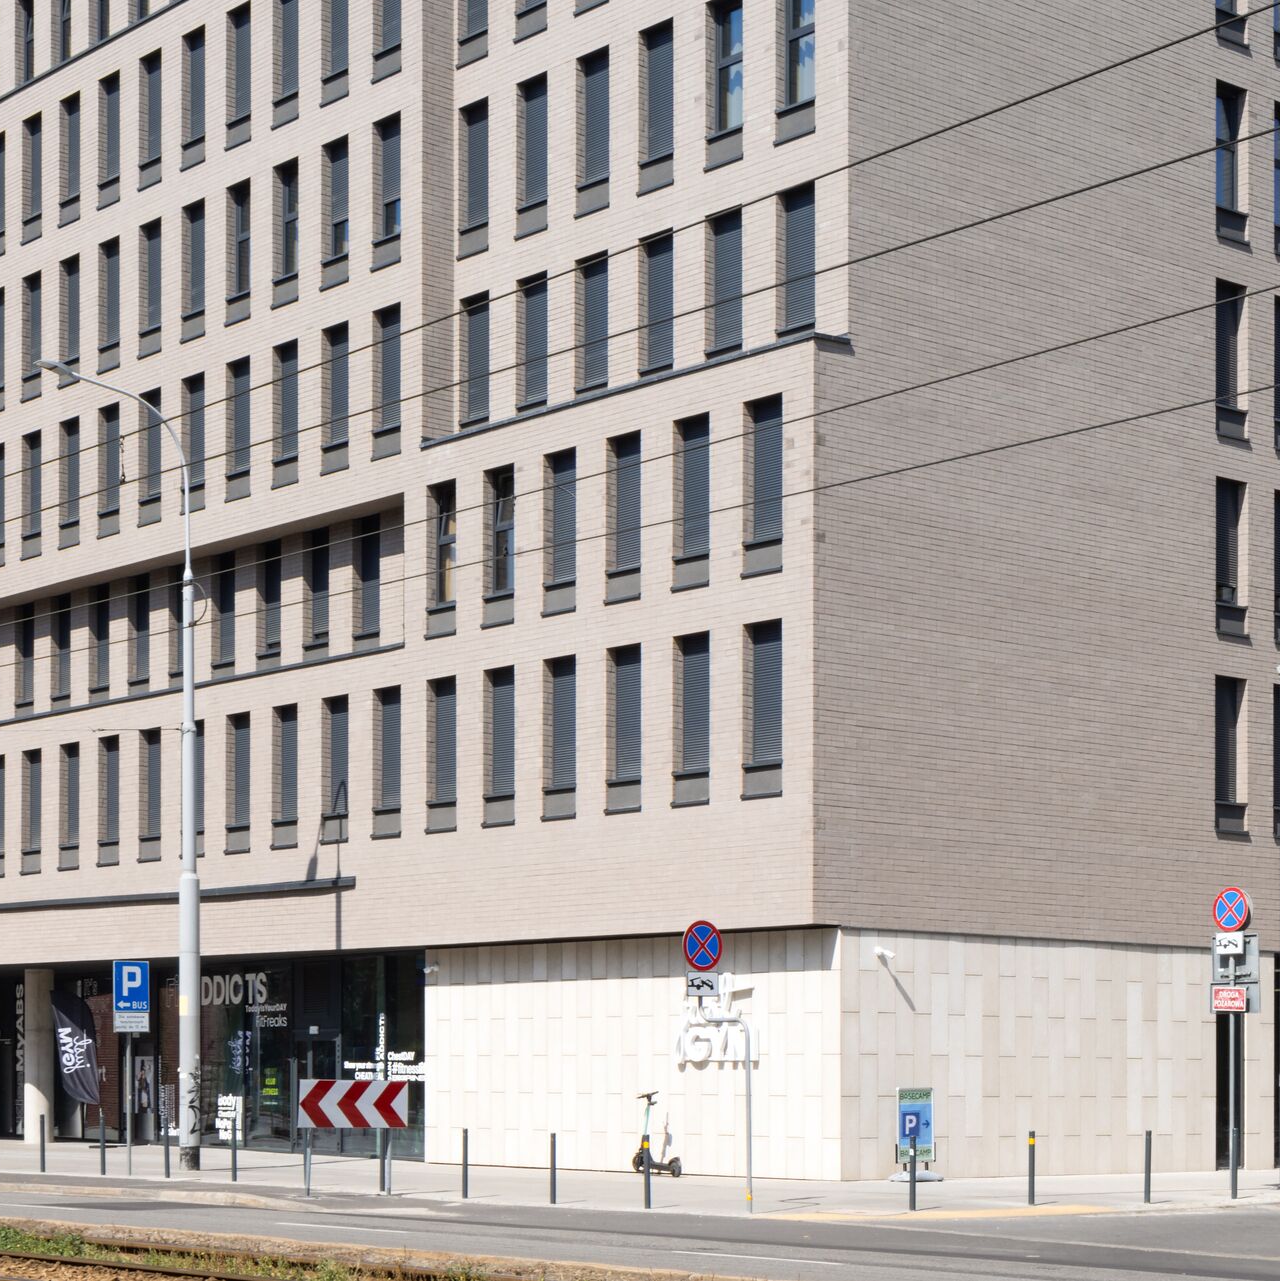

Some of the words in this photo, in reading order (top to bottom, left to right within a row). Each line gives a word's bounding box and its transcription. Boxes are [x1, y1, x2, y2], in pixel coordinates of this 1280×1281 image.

[122, 966, 142, 997] P
[132, 1000, 147, 1009] BUS
[905, 1115, 917, 1135] P
